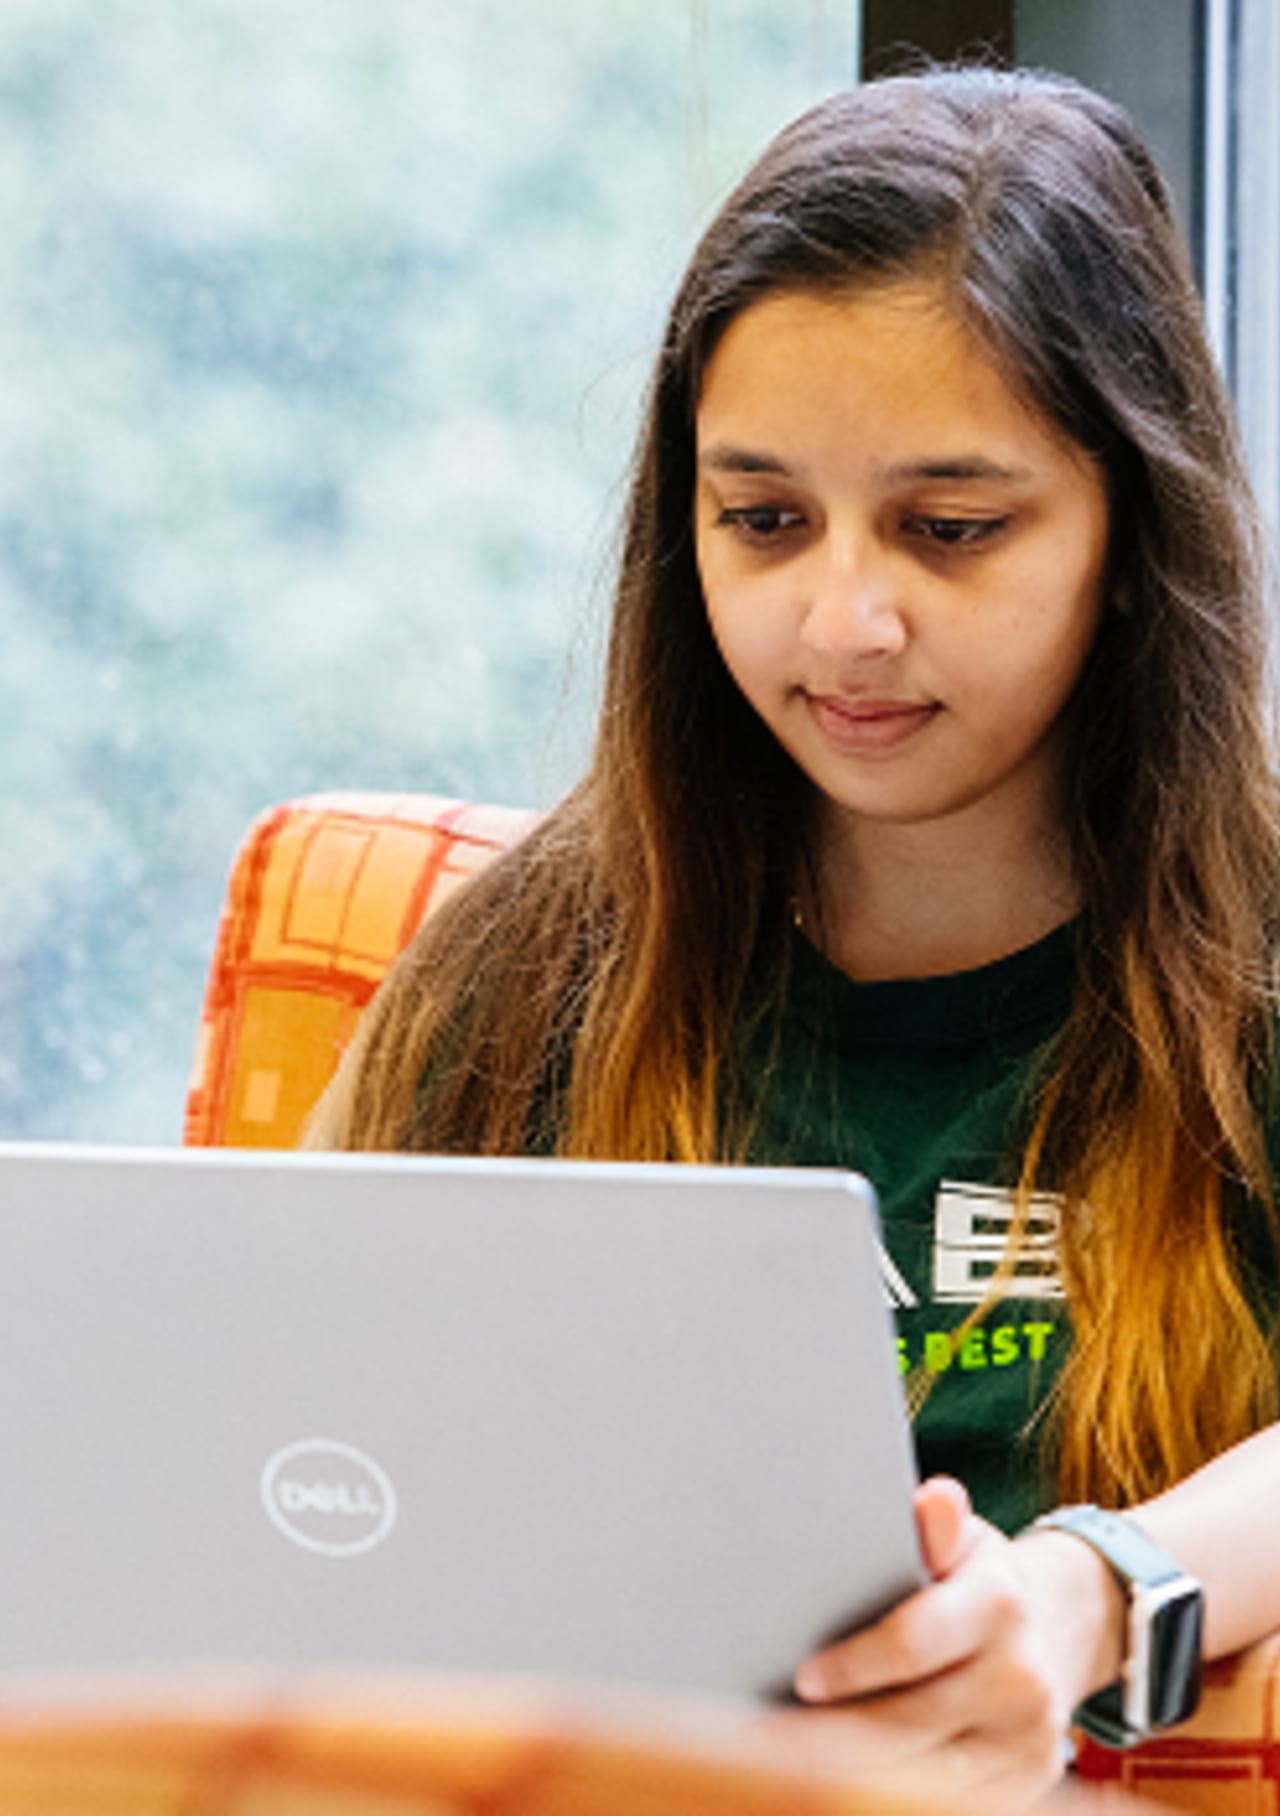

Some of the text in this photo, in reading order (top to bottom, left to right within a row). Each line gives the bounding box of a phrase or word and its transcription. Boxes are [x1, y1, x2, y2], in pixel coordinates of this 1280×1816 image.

[879, 1179, 1067, 1307] B
[924, 1322, 1054, 1372] BEST
[281, 1481, 380, 1515] DELL
